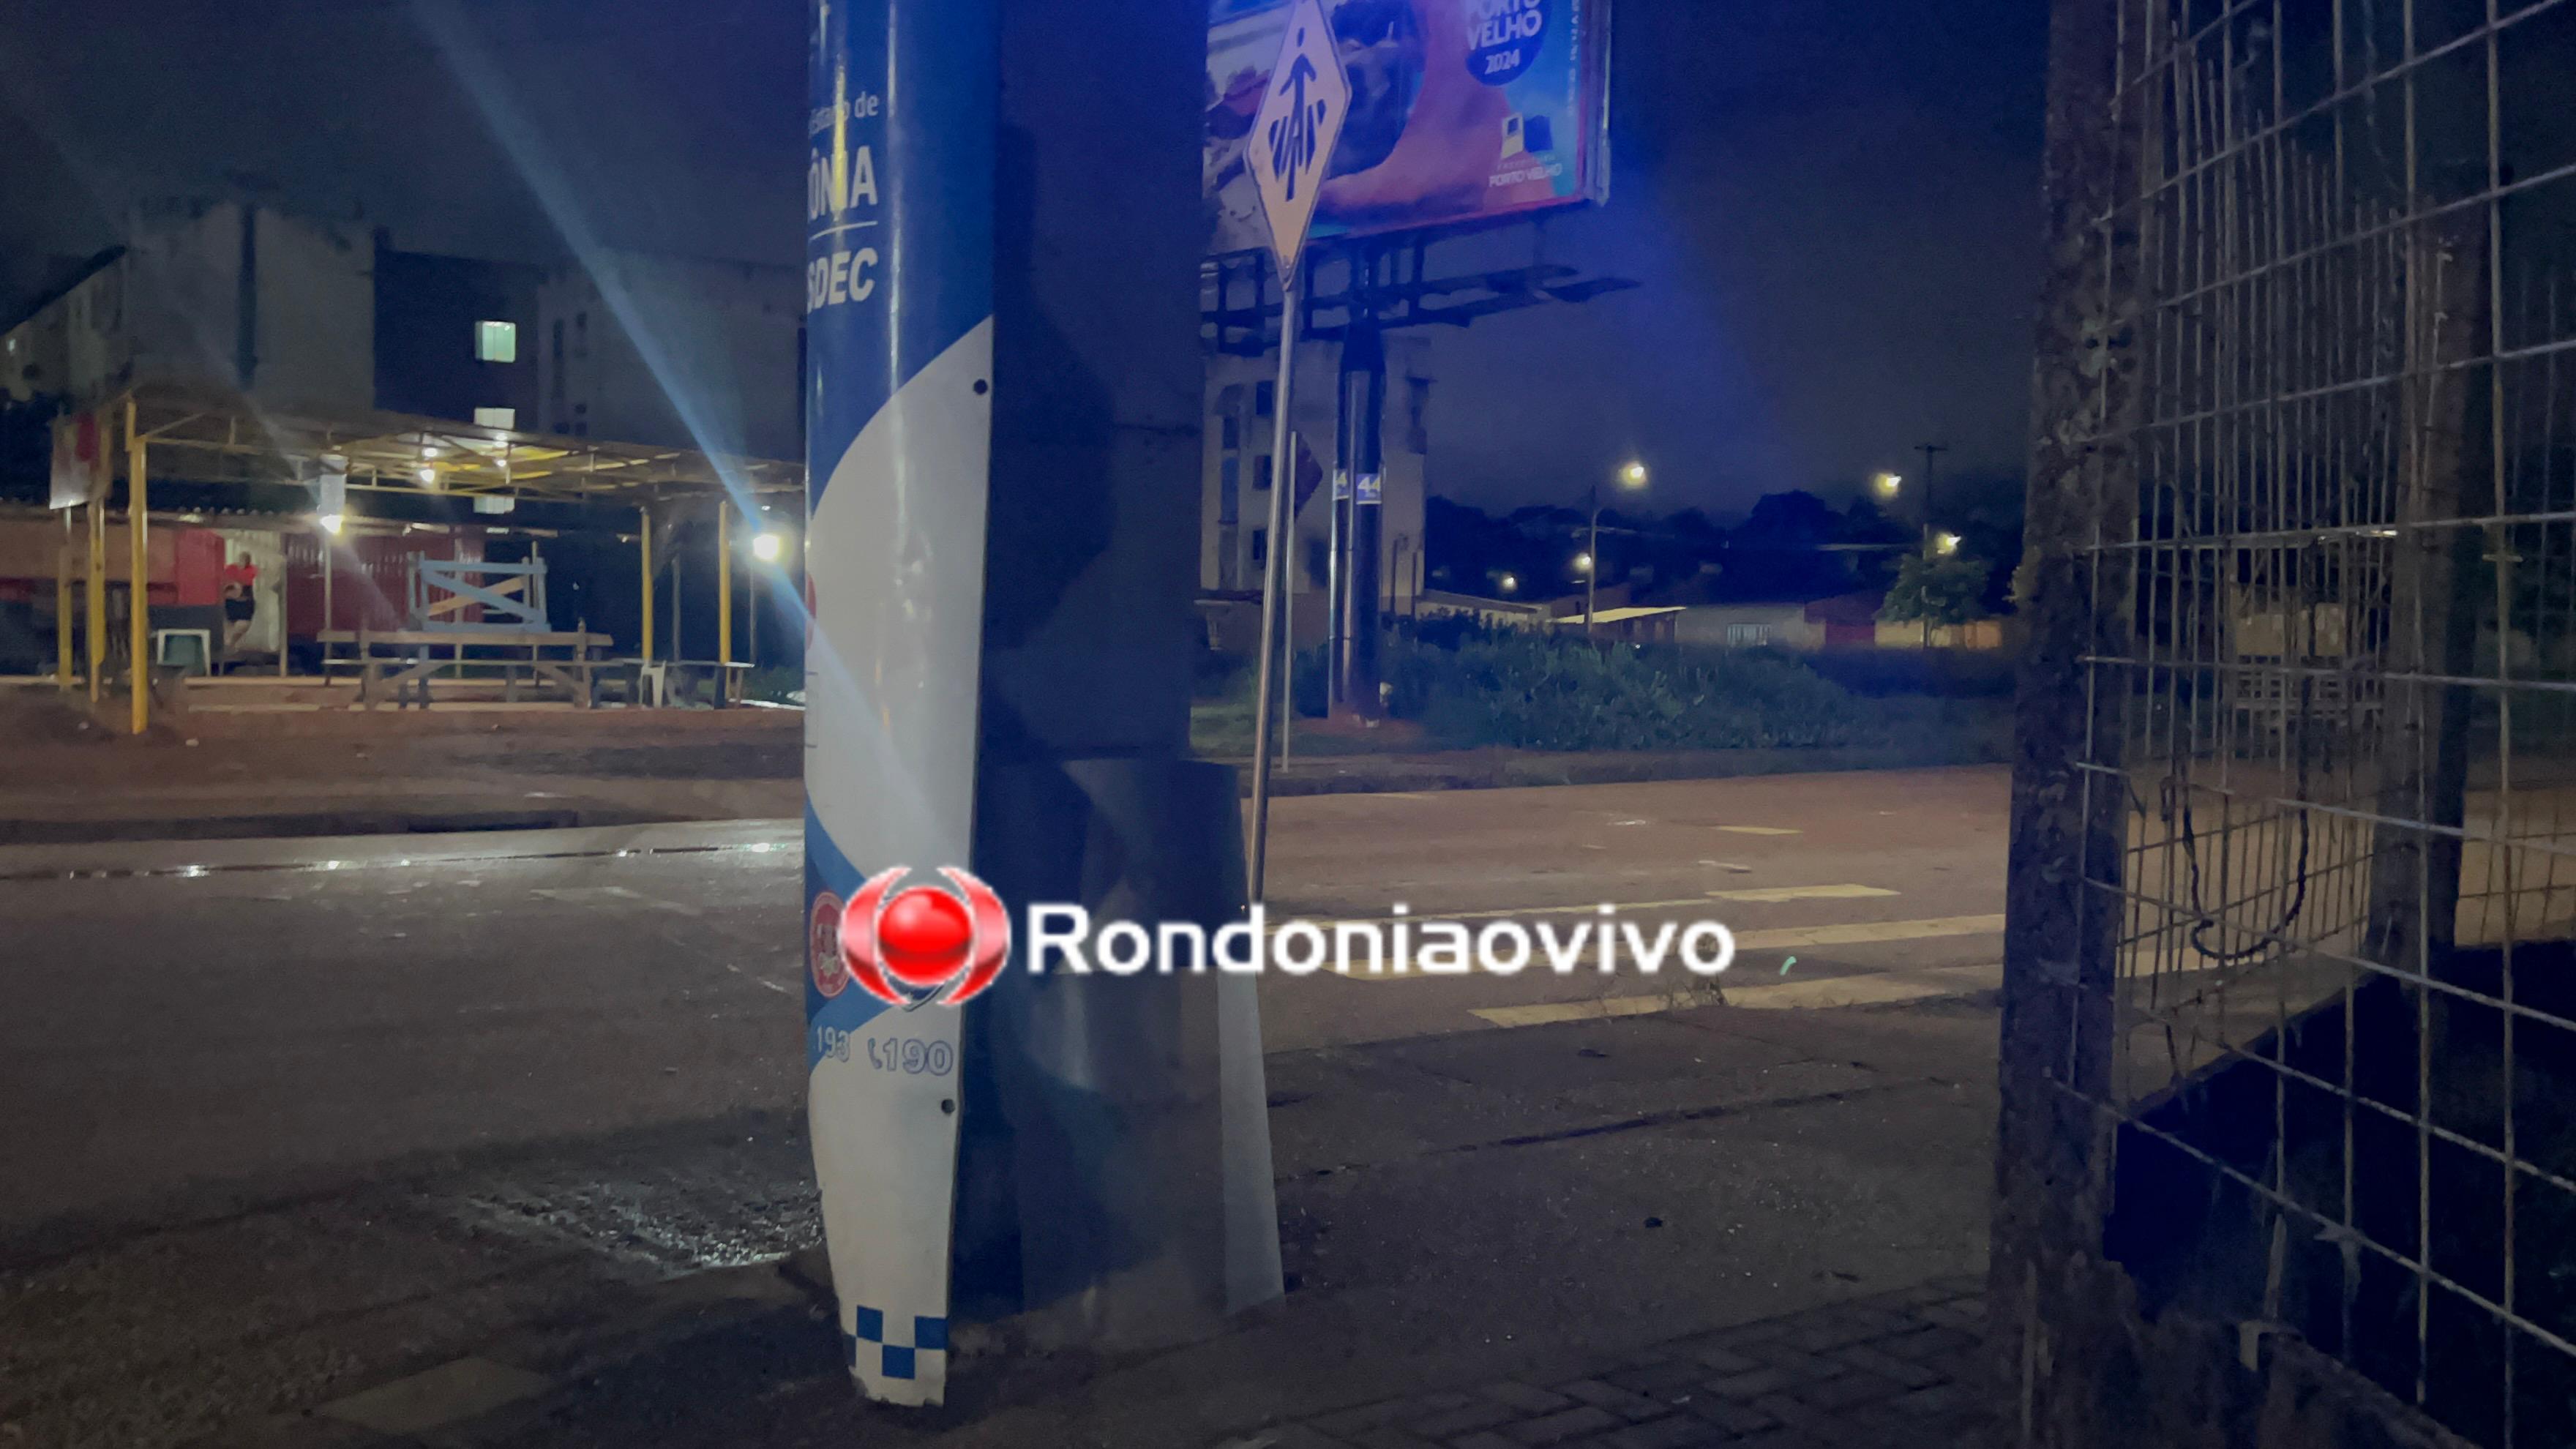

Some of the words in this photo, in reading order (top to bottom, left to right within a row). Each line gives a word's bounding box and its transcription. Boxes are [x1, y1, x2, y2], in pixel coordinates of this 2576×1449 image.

[1467, 10, 1543, 51] VELHO
[1484, 49, 1520, 75] 2024
[855, 91, 879, 119] de
[816, 1025, 851, 1063] 193
[882, 1037, 954, 1077] 190
